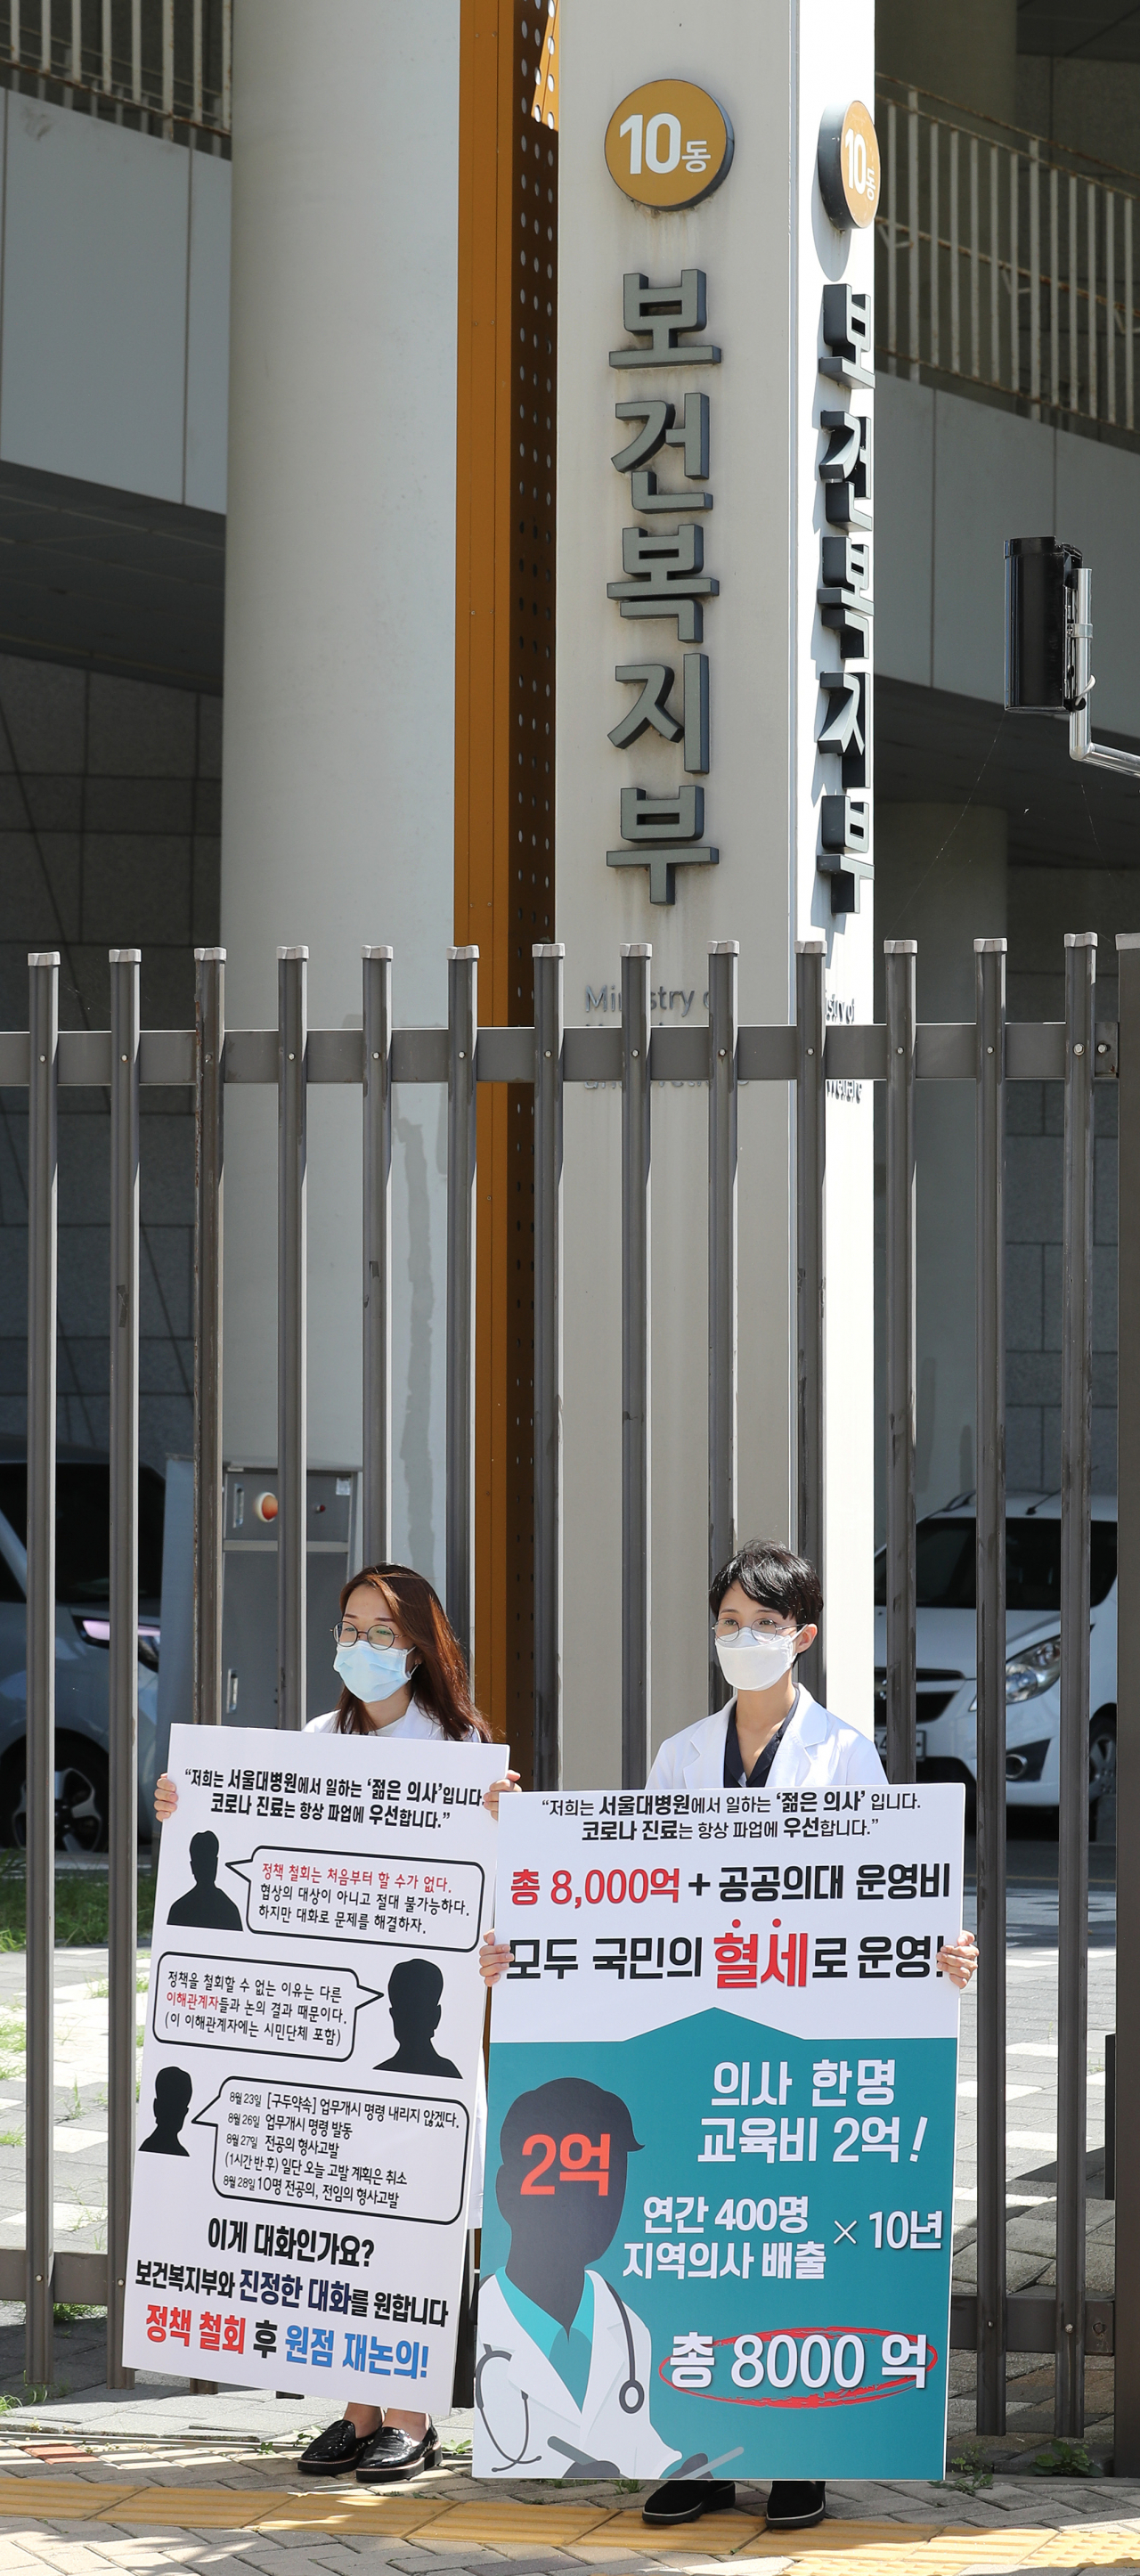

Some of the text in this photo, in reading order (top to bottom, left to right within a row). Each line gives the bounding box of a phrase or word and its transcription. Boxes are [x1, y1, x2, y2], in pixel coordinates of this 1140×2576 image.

[619, 112, 712, 175] 10동
[608, 268, 721, 906] 보건복지부
[817, 282, 875, 915] 보건복지부
[584, 984, 696, 1017] Mistry
[228, 1769, 321, 1795] 서울대병원에서
[326, 1778, 362, 1797] 일하는
[211, 1793, 251, 1815] 코로나
[256, 1796, 296, 1818] 진료는
[300, 1801, 324, 1821] 항상
[328, 1804, 364, 1823] 파업에
[599, 1794, 721, 1816] 서울대병원에서
[726, 1796, 770, 1814] 일하는
[871, 1793, 920, 1810] 입니다.
[582, 1821, 637, 1841] 코로나
[642, 1820, 693, 1840] 진료는
[698, 1822, 729, 1839] 항상
[733, 1821, 778, 1838] 파업에
[262, 1863, 452, 1893] 정책 철회는 처음부터 할 수가 없다.
[511, 1869, 540, 1906] 총
[551, 1868, 680, 1909] 8,000억
[719, 1865, 843, 1903] 공공의대
[856, 1863, 949, 1900] 운영비
[261, 1883, 469, 1916] 협상의 대상이 아니고 절대 불가능하다.
[259, 1904, 426, 1935] 하지만 대화로 문제를 해결하자.
[507, 1931, 945, 1989] 모두 국민의 혈세로 운영!
[168, 1971, 342, 2003] 정책을 철회할 수 없는 이유는 다른
[167, 1992, 346, 2025] 이해관계자들과 논의 결과 때문이다.
[166, 2011, 341, 2047] (이 이해관계자에는 시민단체 포함)
[712, 2058, 895, 2107] 의사 한명
[228, 2113, 353, 2140] 8월 26일 업무개시 명령 발동
[230, 2092, 460, 2129] 8월 23일 [구두약속] 업무개시 명령 내리지 않겠다.
[226, 2133, 339, 2159] 8월 27일 전공의 형사고발
[698, 2116, 927, 2164] 교육비 2억!
[224, 2152, 407, 2186] (1시간 반 후) 일단 오늘 고발 계획은 취소
[521, 2134, 610, 2197] 2억
[224, 2175, 236, 2188] 8월
[285, 2179, 319, 2200] 전공의,
[322, 2183, 354, 2202] 전임의
[356, 2187, 399, 2209] 형사고발
[644, 2197, 808, 2235] 연간 400명
[868, 2211, 942, 2249] 10년
[208, 2218, 374, 2267] 이게 대화인가요?
[623, 2241, 826, 2279] 지역의사 배출
[135, 2259, 448, 2327] 보건복지부와 진정한 대화를 원합니다
[146, 2304, 428, 2379] 정책 철회 후 원점 재논의!
[670, 2331, 926, 2389] 총 8000 억
